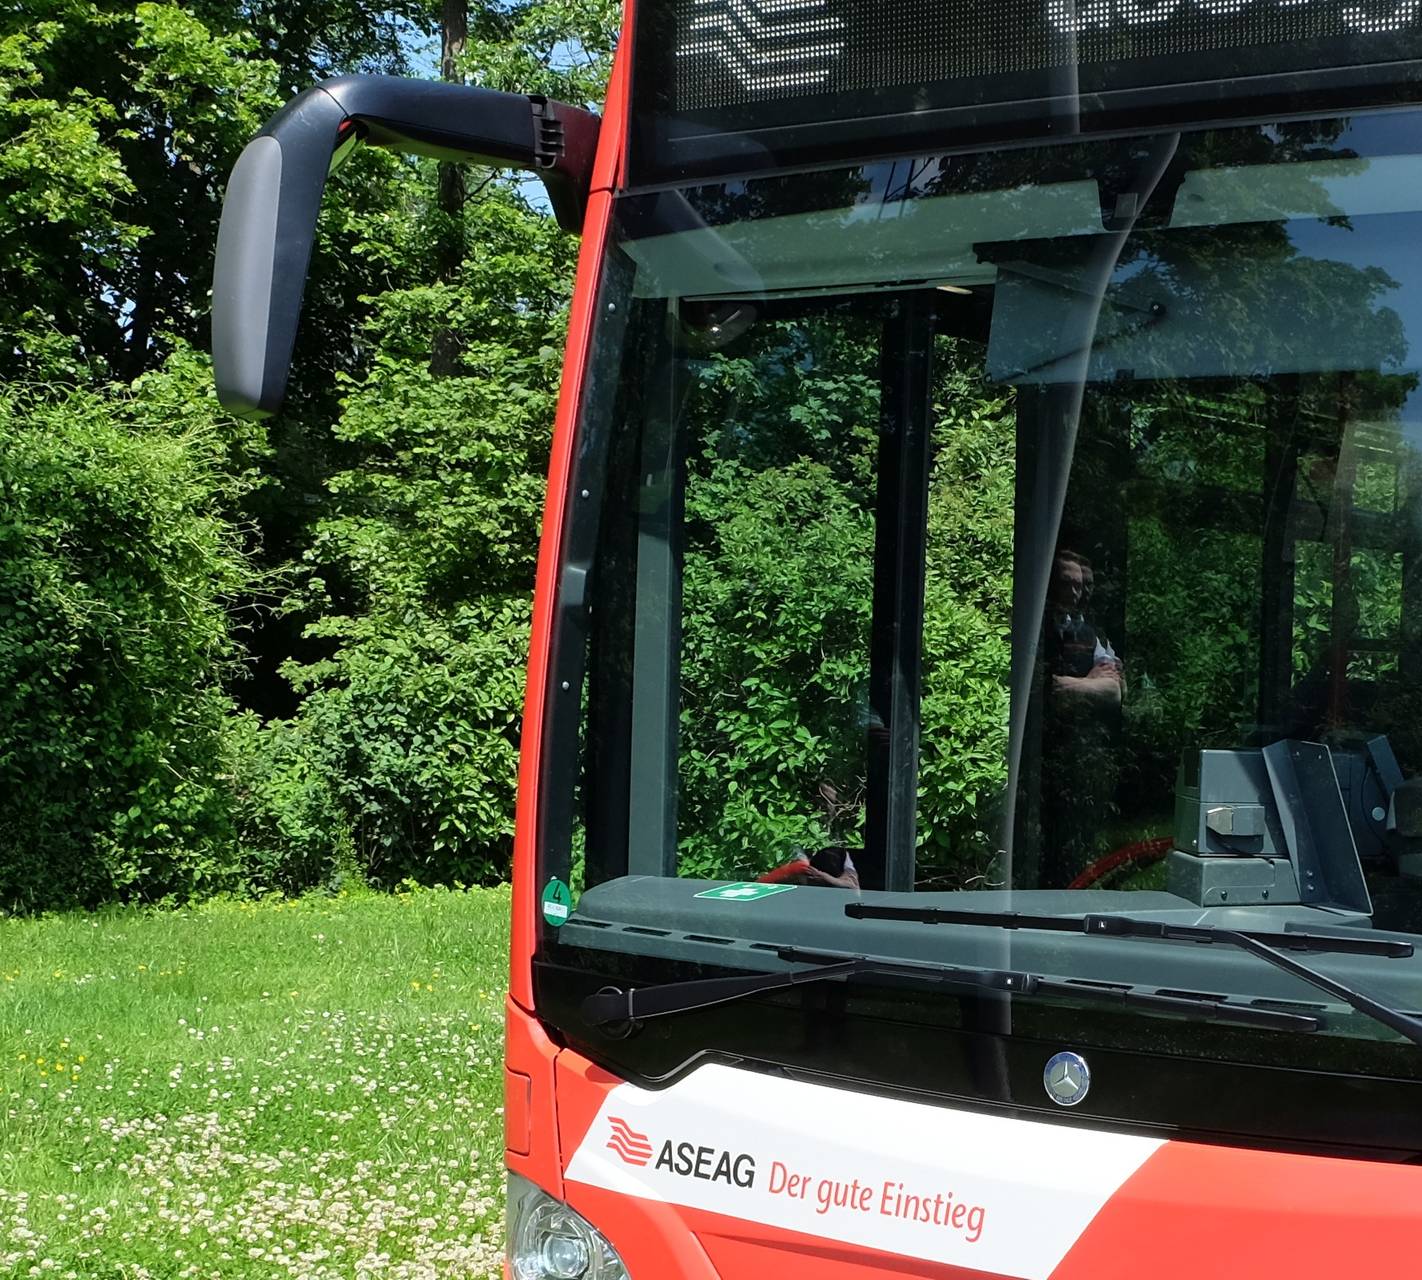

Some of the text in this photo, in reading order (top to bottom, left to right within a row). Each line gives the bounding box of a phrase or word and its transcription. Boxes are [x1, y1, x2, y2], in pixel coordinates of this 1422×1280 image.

[553, 882, 562, 904] 4
[654, 1139, 756, 1189] ASEAG
[768, 1161, 986, 1243] Der gute Einstieg
